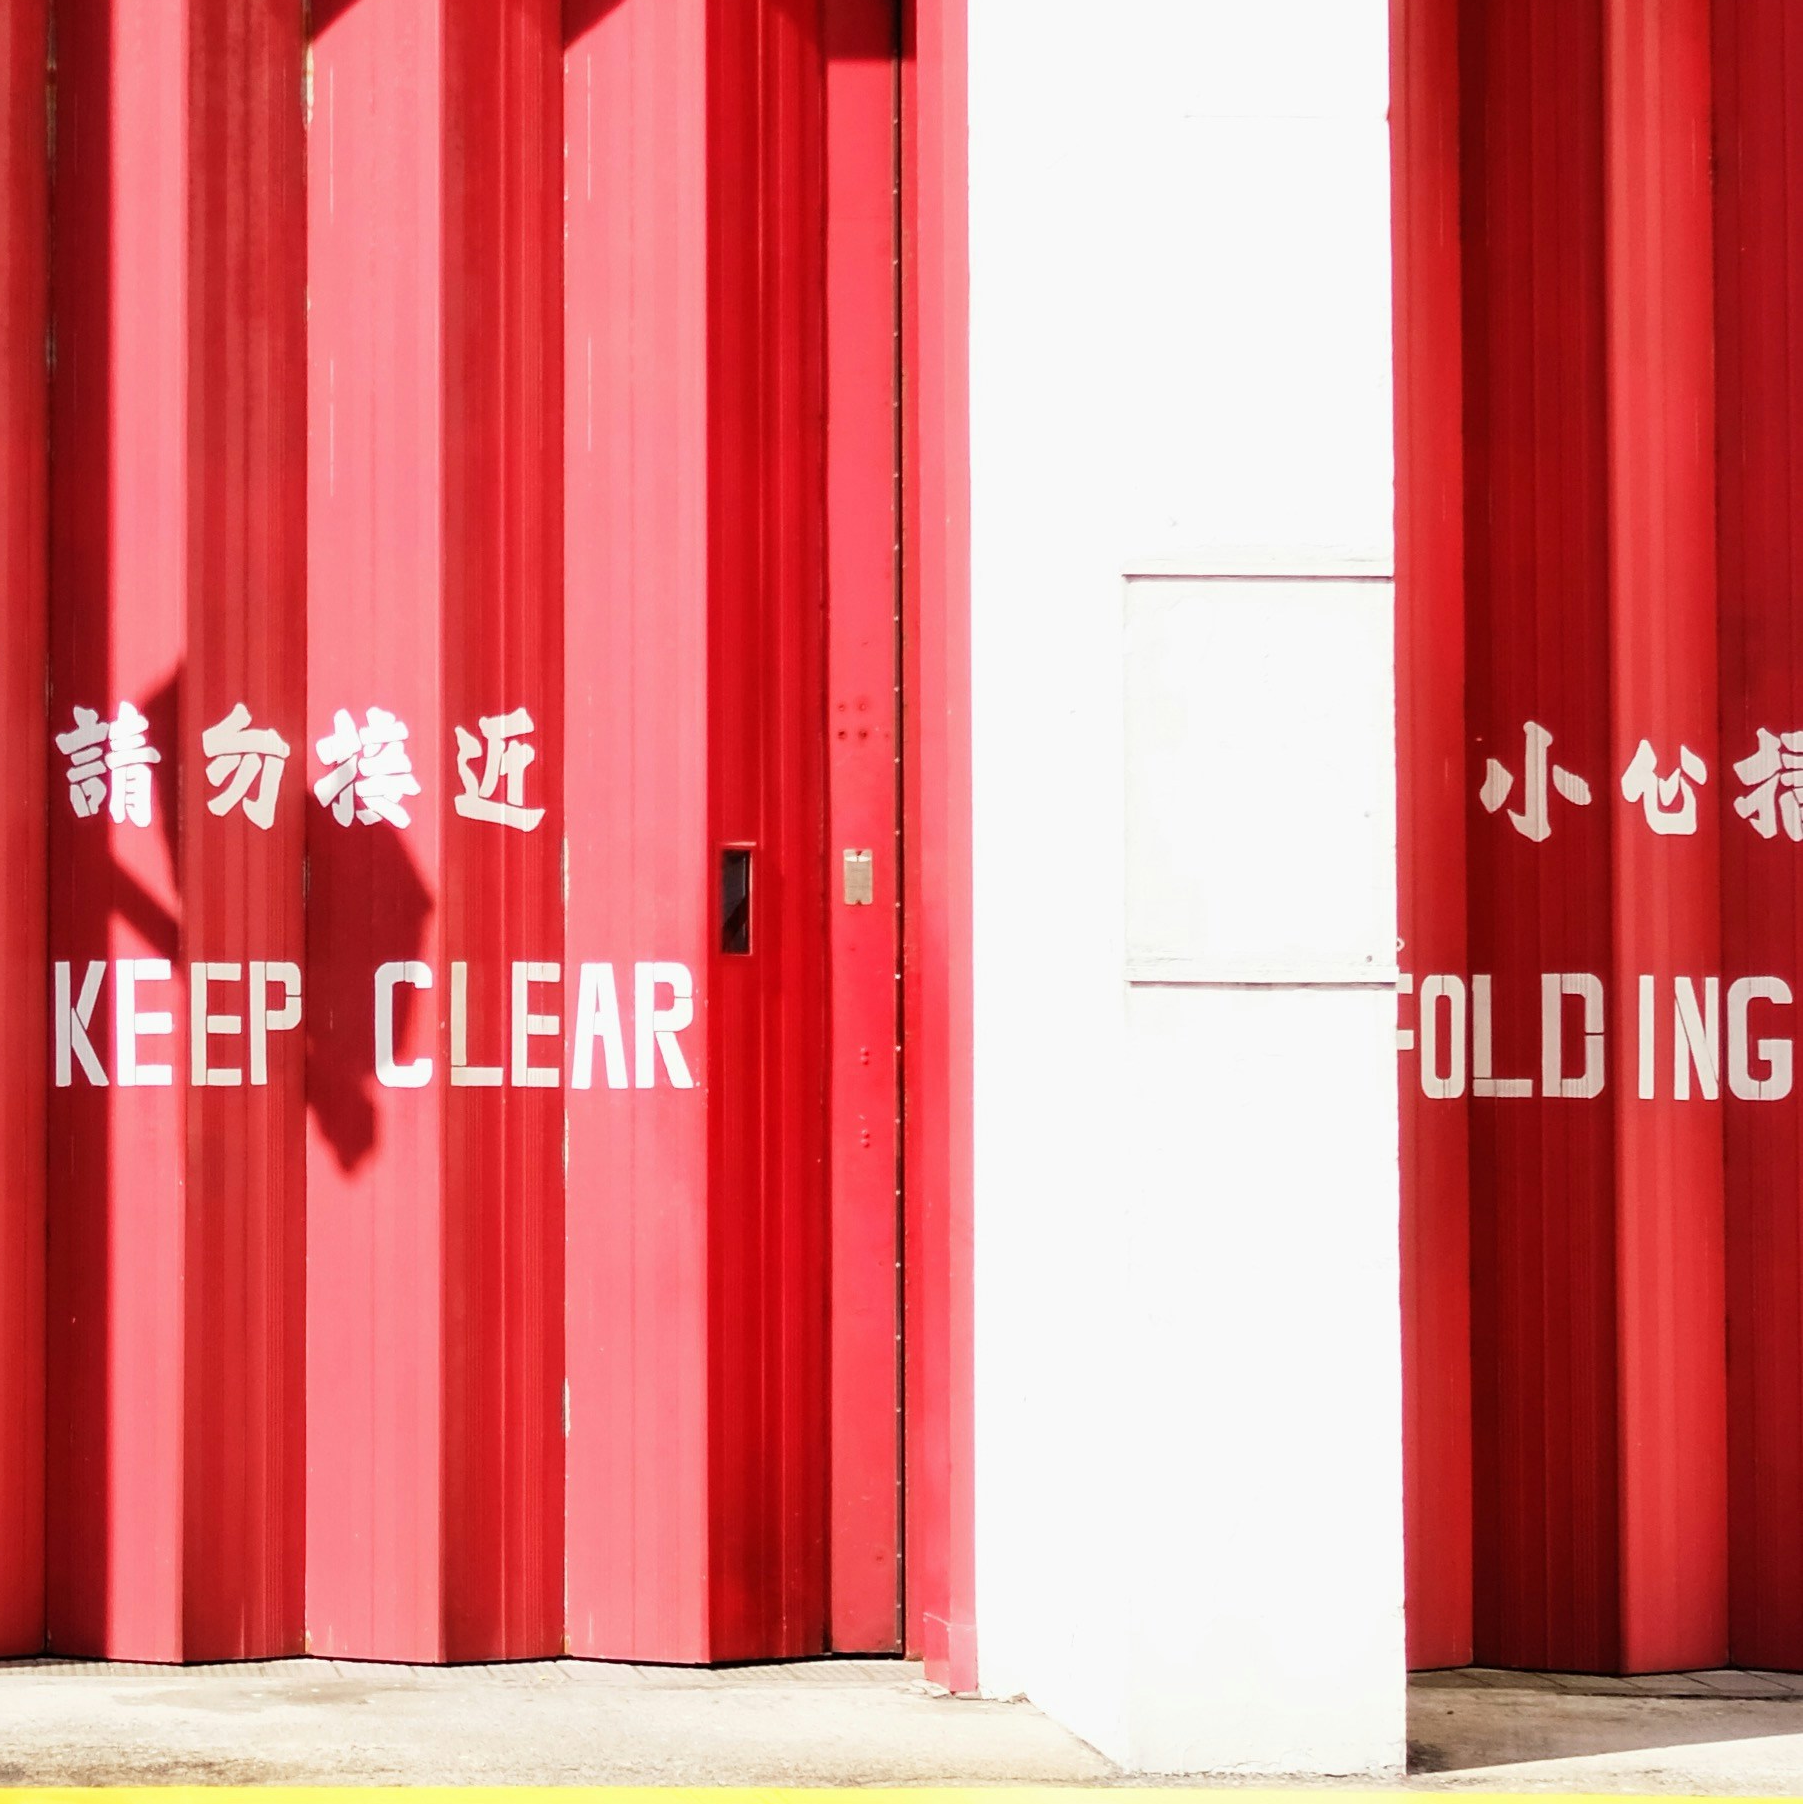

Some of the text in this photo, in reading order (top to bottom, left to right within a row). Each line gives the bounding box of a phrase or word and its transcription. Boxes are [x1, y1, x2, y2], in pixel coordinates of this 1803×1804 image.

[55, 700, 546, 832] 請勿接近
[55, 958, 302, 1087] KEEP
[374, 961, 695, 1090] CLEAR
[1397, 971, 1793, 1101] OLDING
